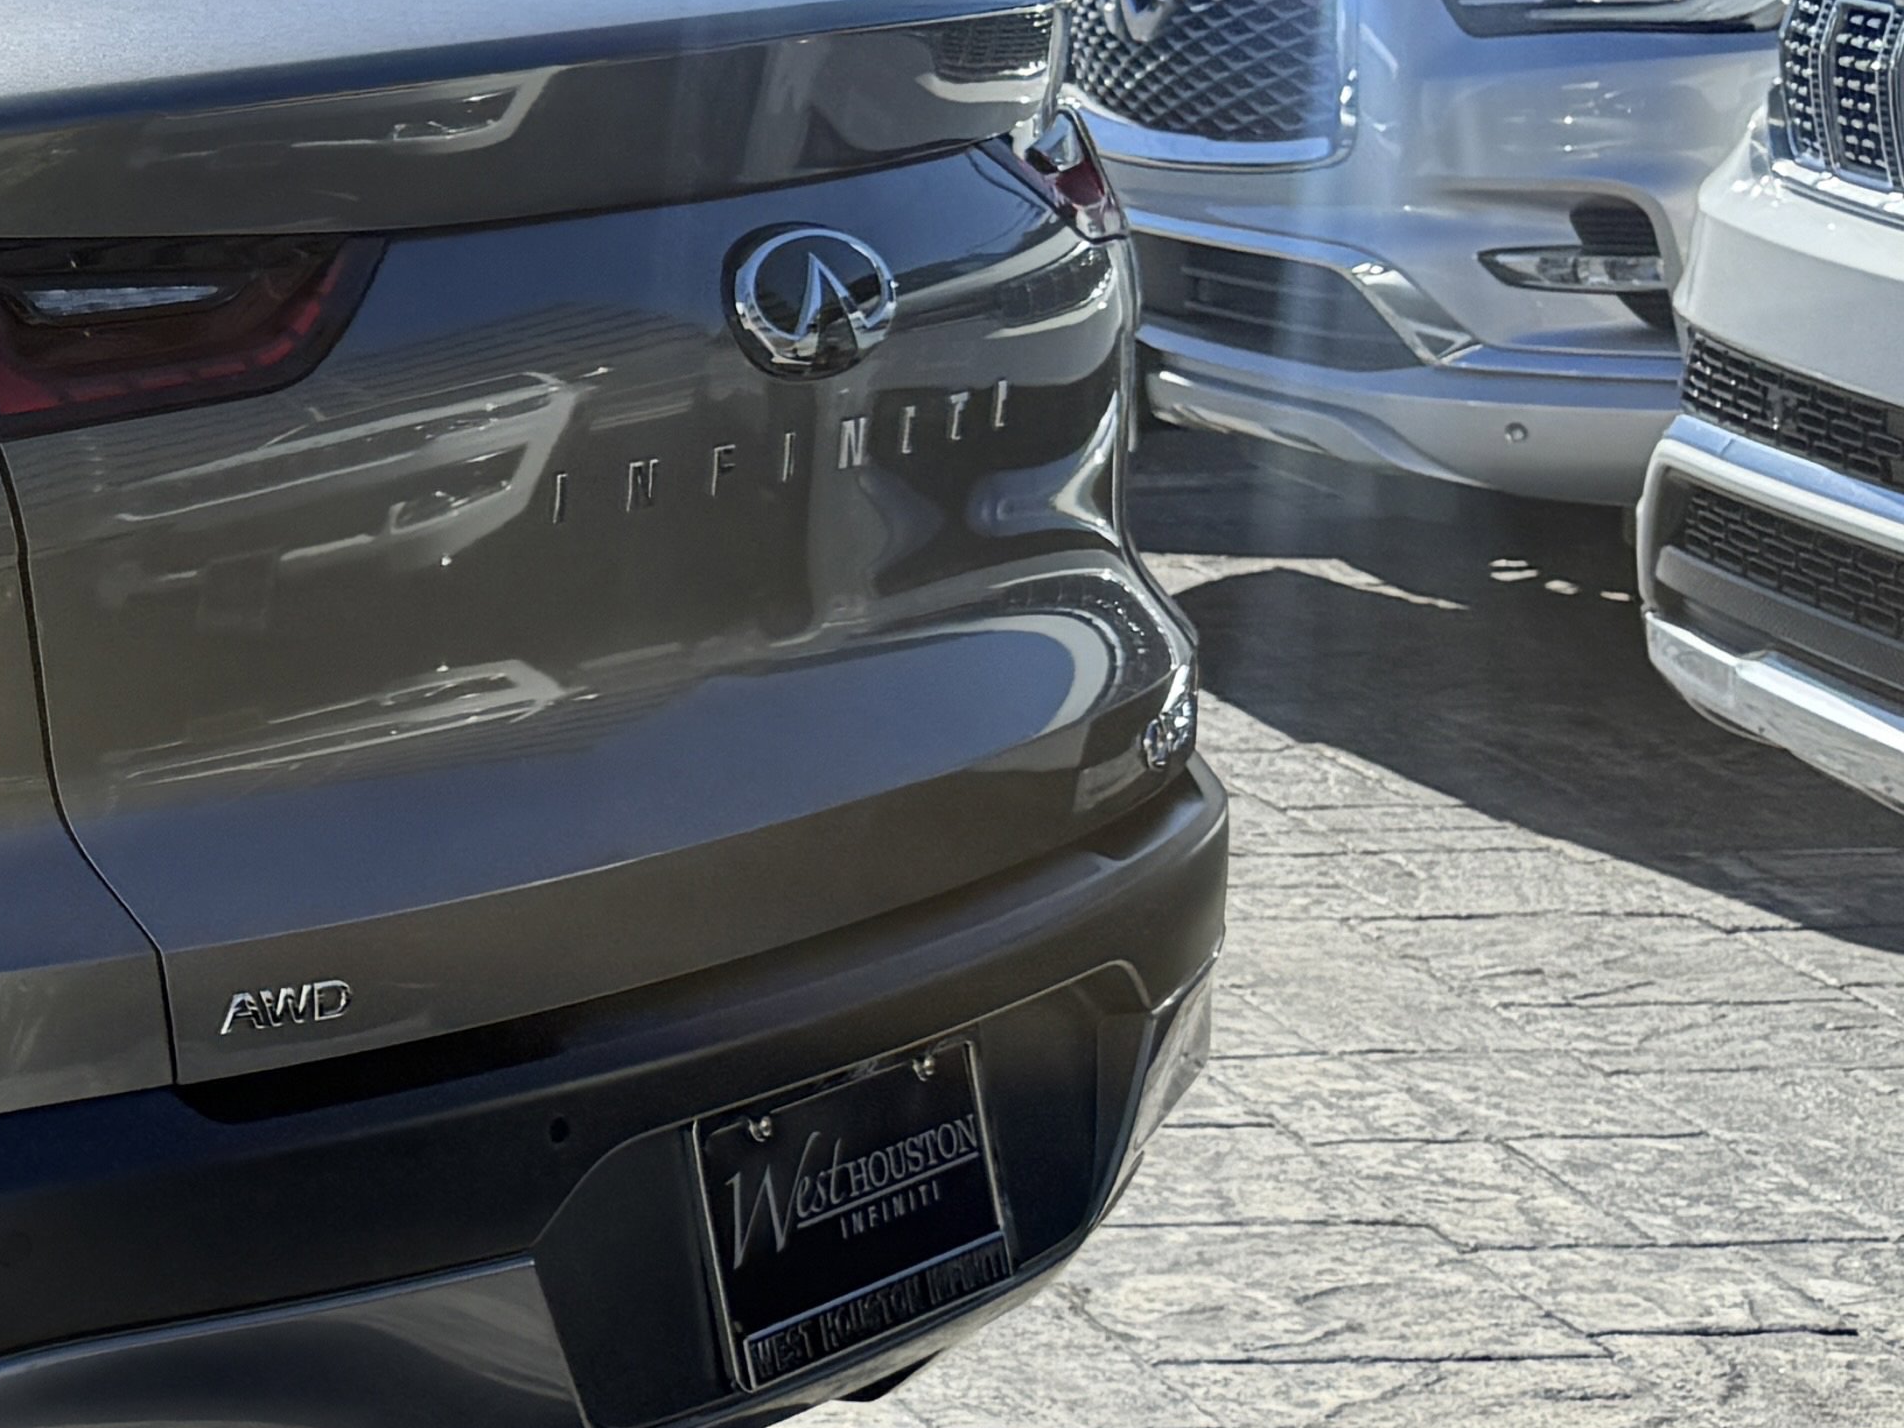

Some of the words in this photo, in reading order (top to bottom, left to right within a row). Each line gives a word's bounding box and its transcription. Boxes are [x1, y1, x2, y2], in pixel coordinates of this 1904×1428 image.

[552, 380, 1009, 524] INFINITI
[219, 979, 354, 1035] AWD
[840, 1180, 941, 1240] INFINITI
